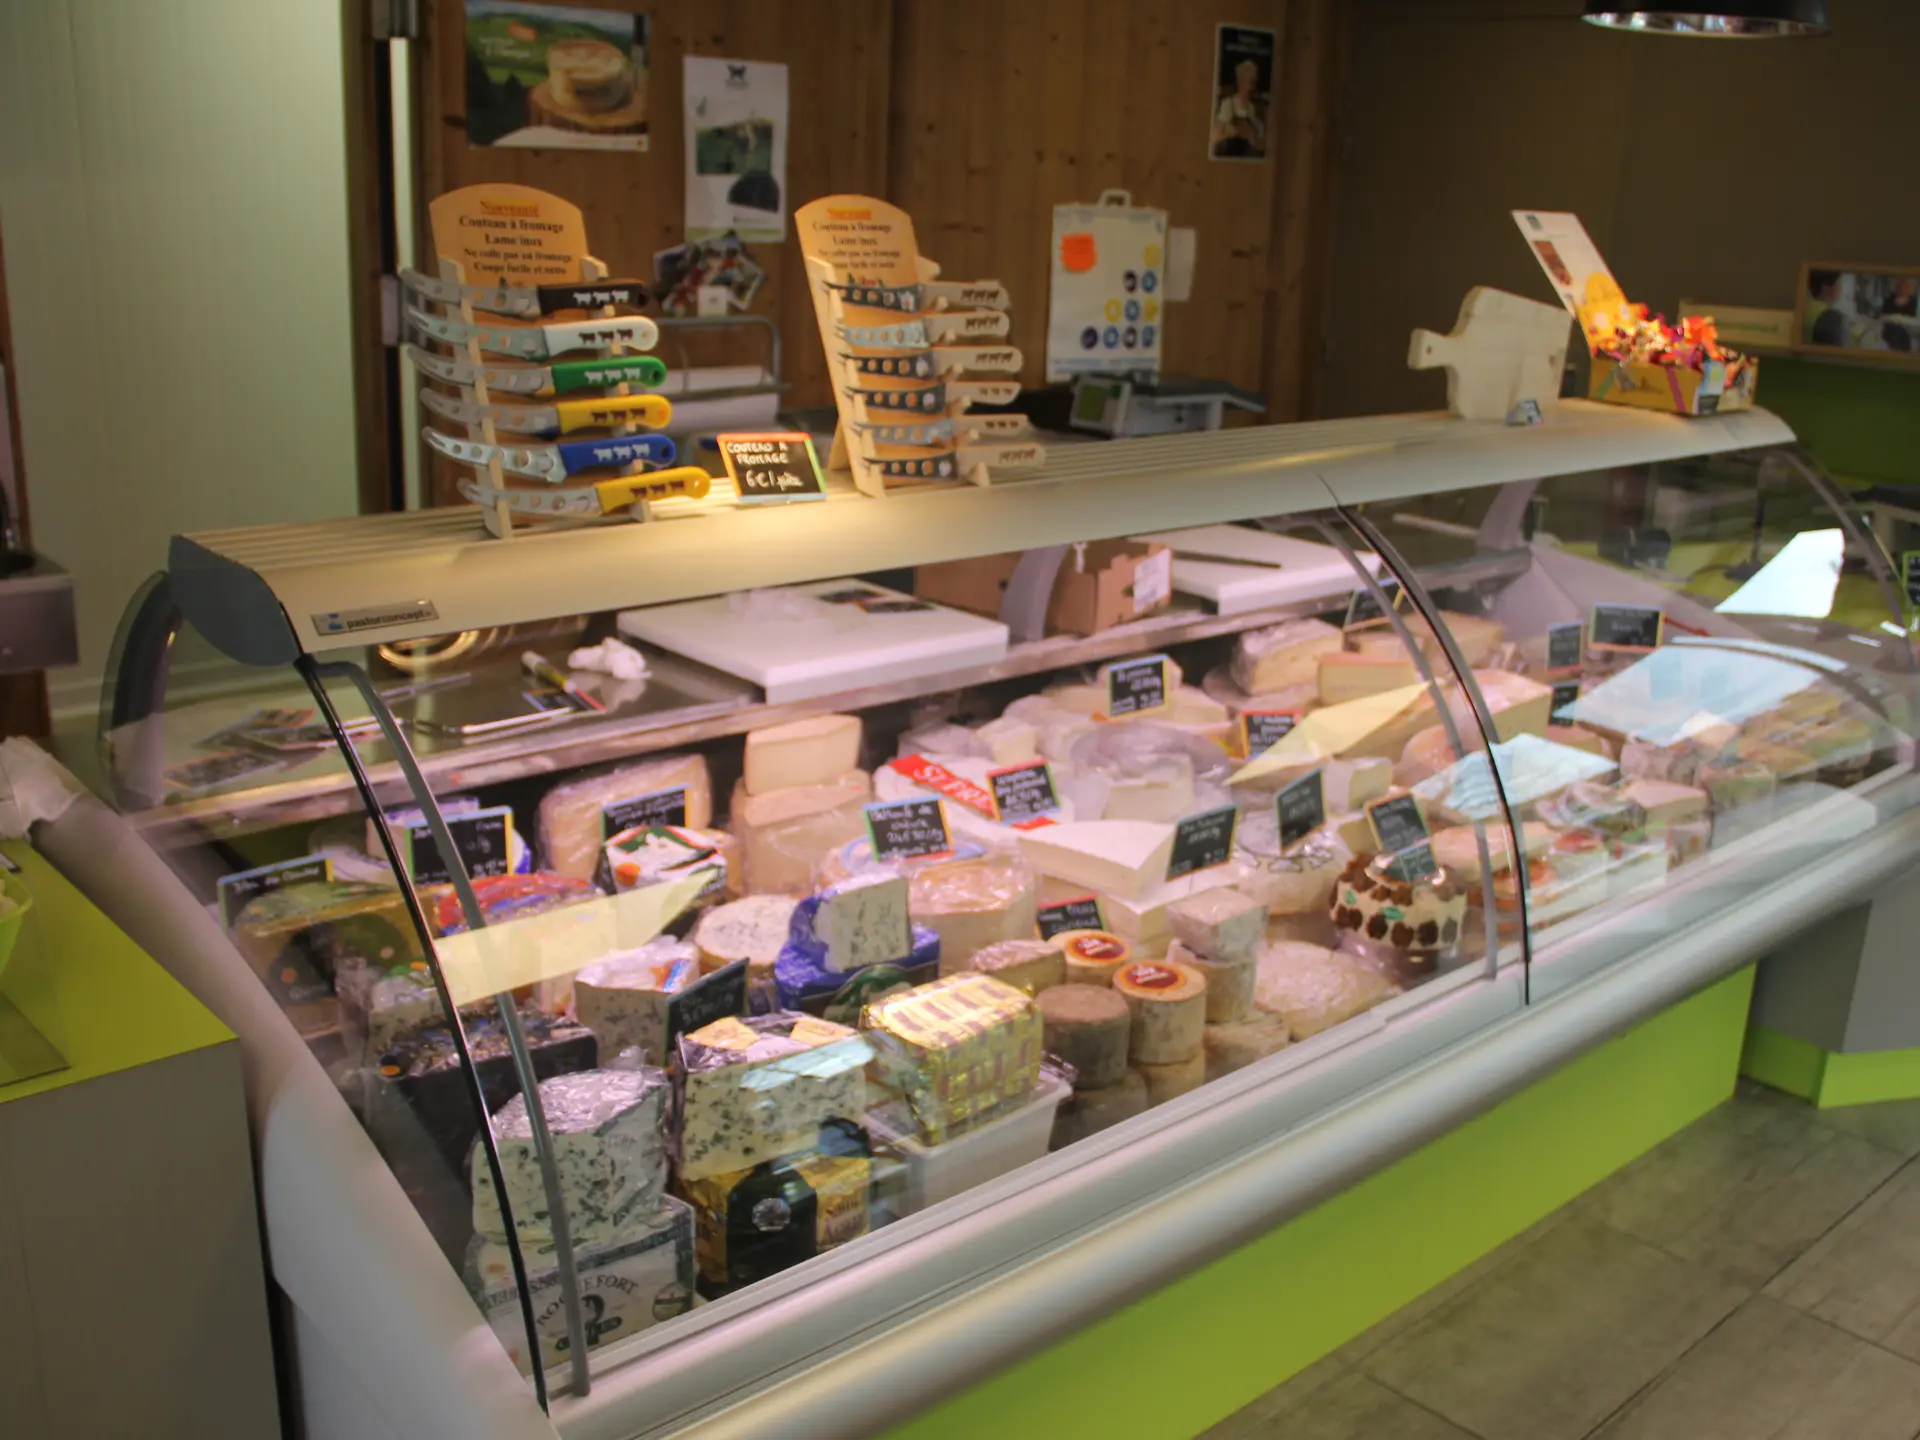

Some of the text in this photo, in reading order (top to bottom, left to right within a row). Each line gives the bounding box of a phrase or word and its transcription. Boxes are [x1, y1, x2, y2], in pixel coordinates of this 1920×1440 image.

[460, 215, 506, 230] Couteau
[519, 219, 564, 234] fromage
[485, 232, 516, 245] Lame
[736, 452, 789, 465] FROMAGE
